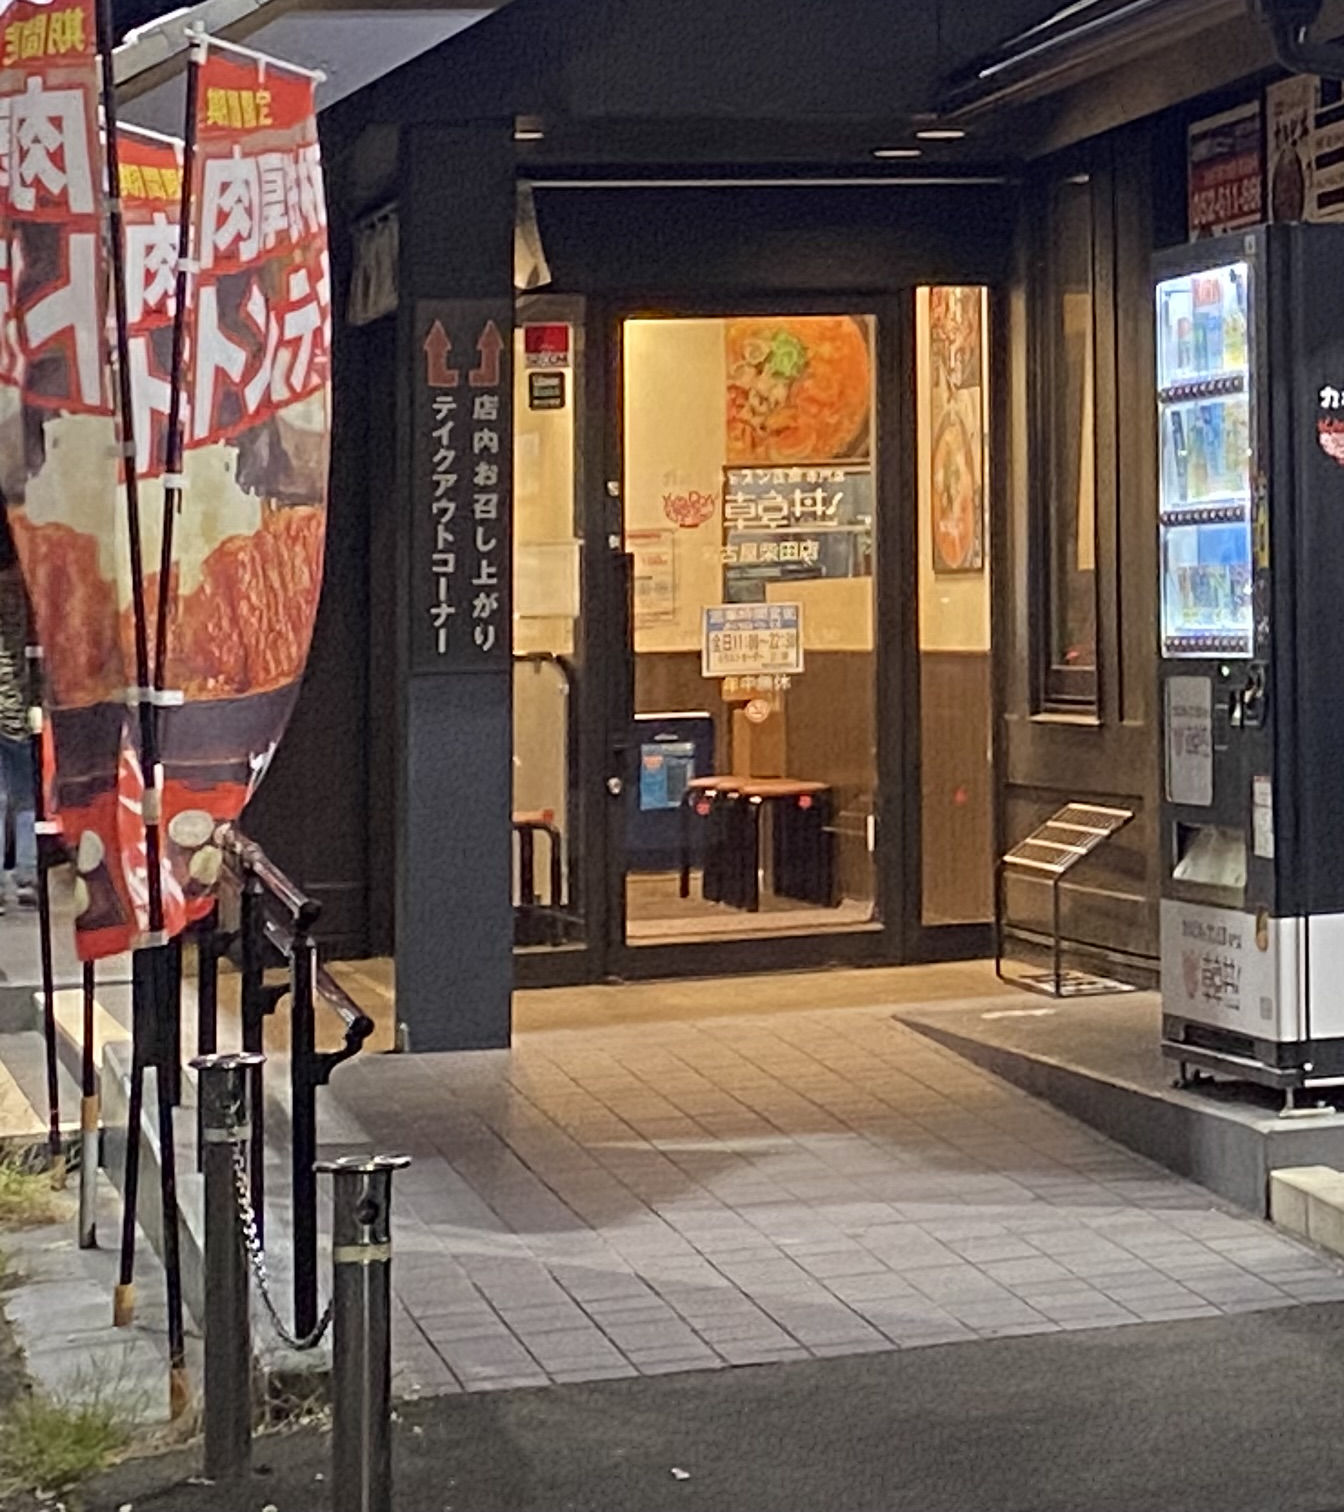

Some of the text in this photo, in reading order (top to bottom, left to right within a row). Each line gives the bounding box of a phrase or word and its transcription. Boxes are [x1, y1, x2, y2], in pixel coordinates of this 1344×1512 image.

[430, 395, 457, 654] テイクアウトコーナー
[472, 395, 499, 652] 店内お召し上がり
